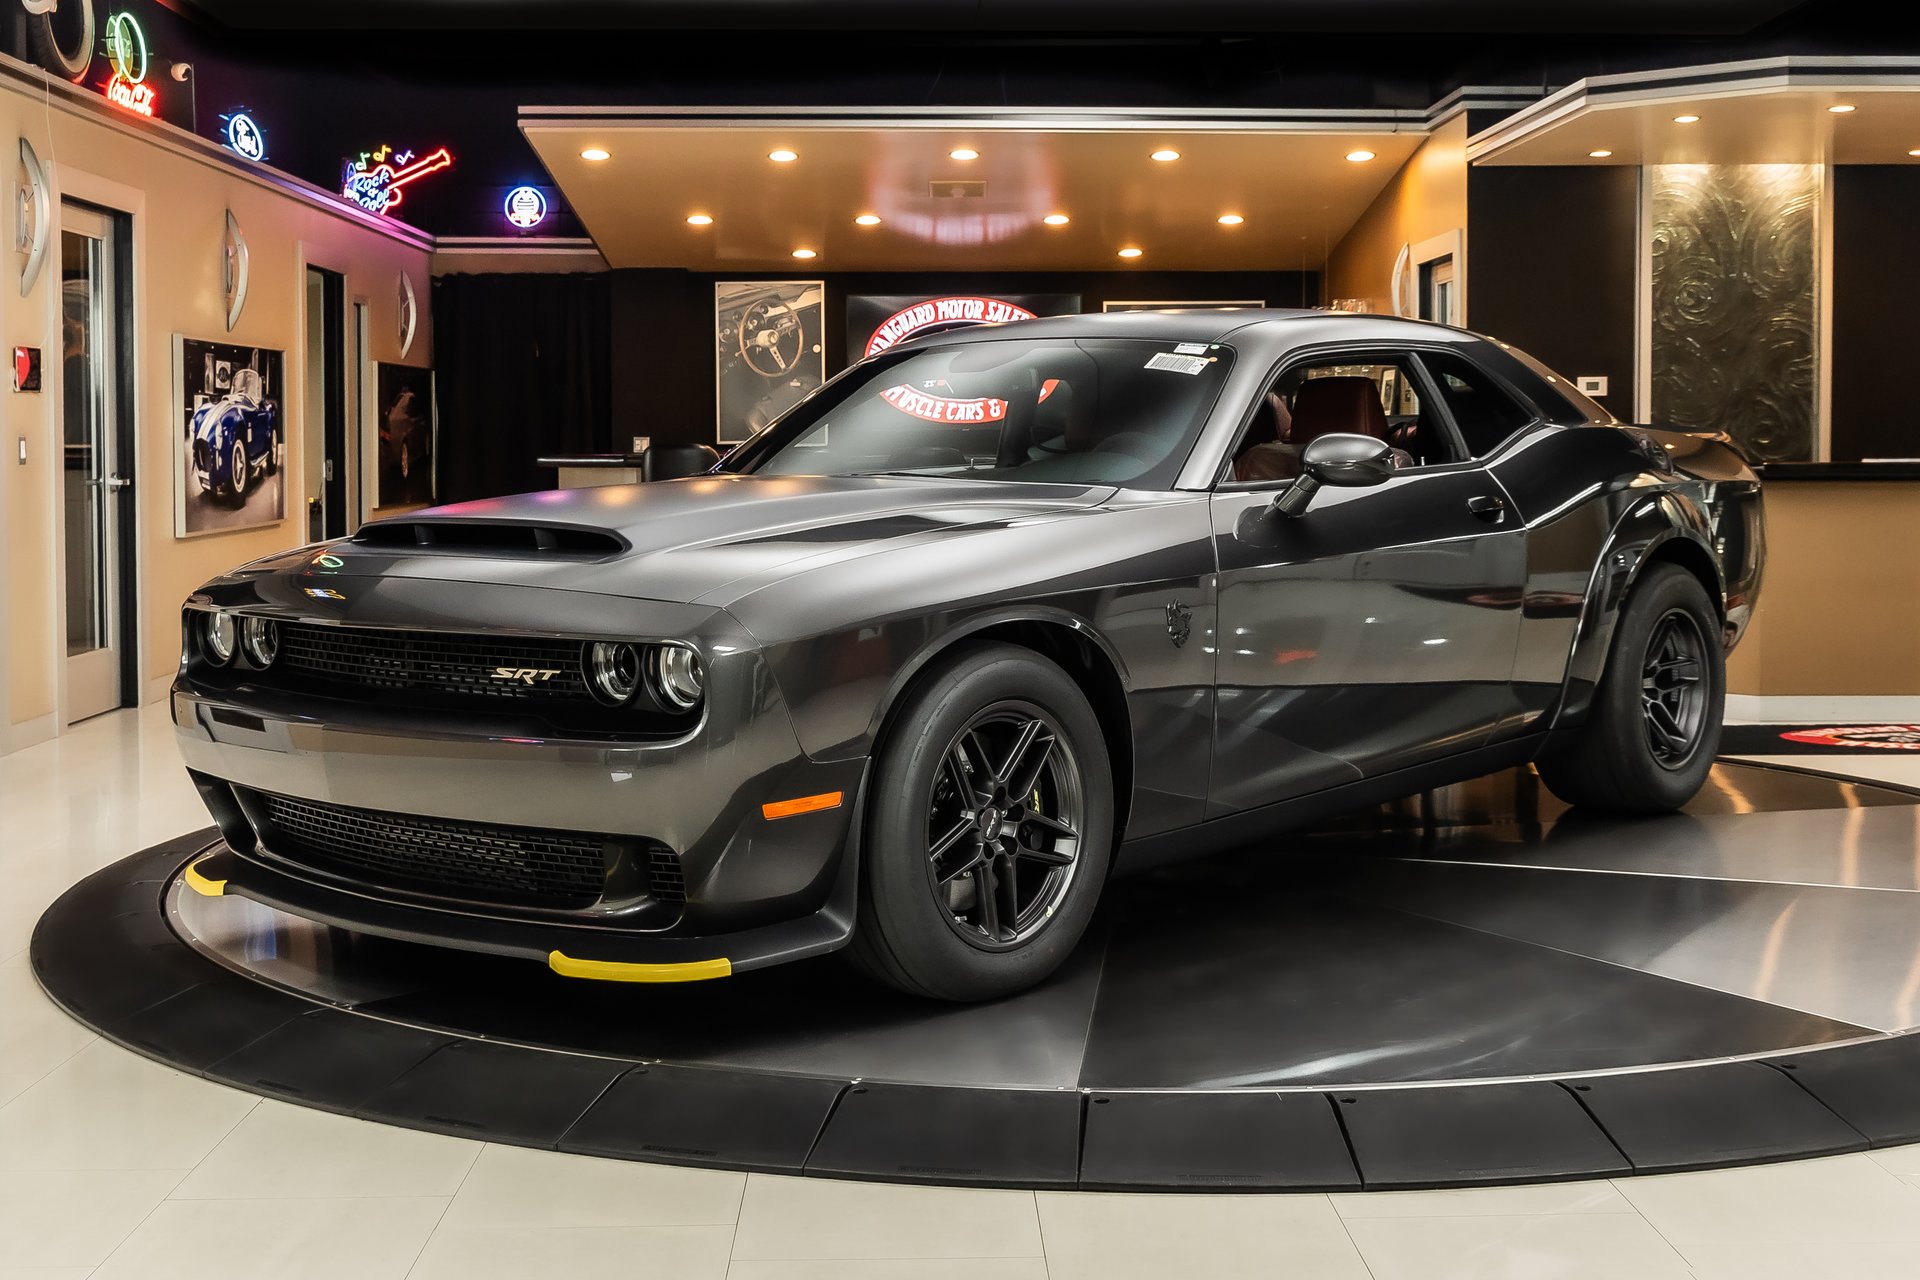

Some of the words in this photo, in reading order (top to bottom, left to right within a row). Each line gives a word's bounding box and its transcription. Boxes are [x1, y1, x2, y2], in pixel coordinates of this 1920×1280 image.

[353, 167, 390, 192] Rock
[868, 303, 936, 355] VANGUARD
[936, 299, 985, 321] MOTOR
[884, 385, 945, 419] MUSCLE
[946, 401, 985, 420] CARS
[490, 667, 561, 685] SRT
